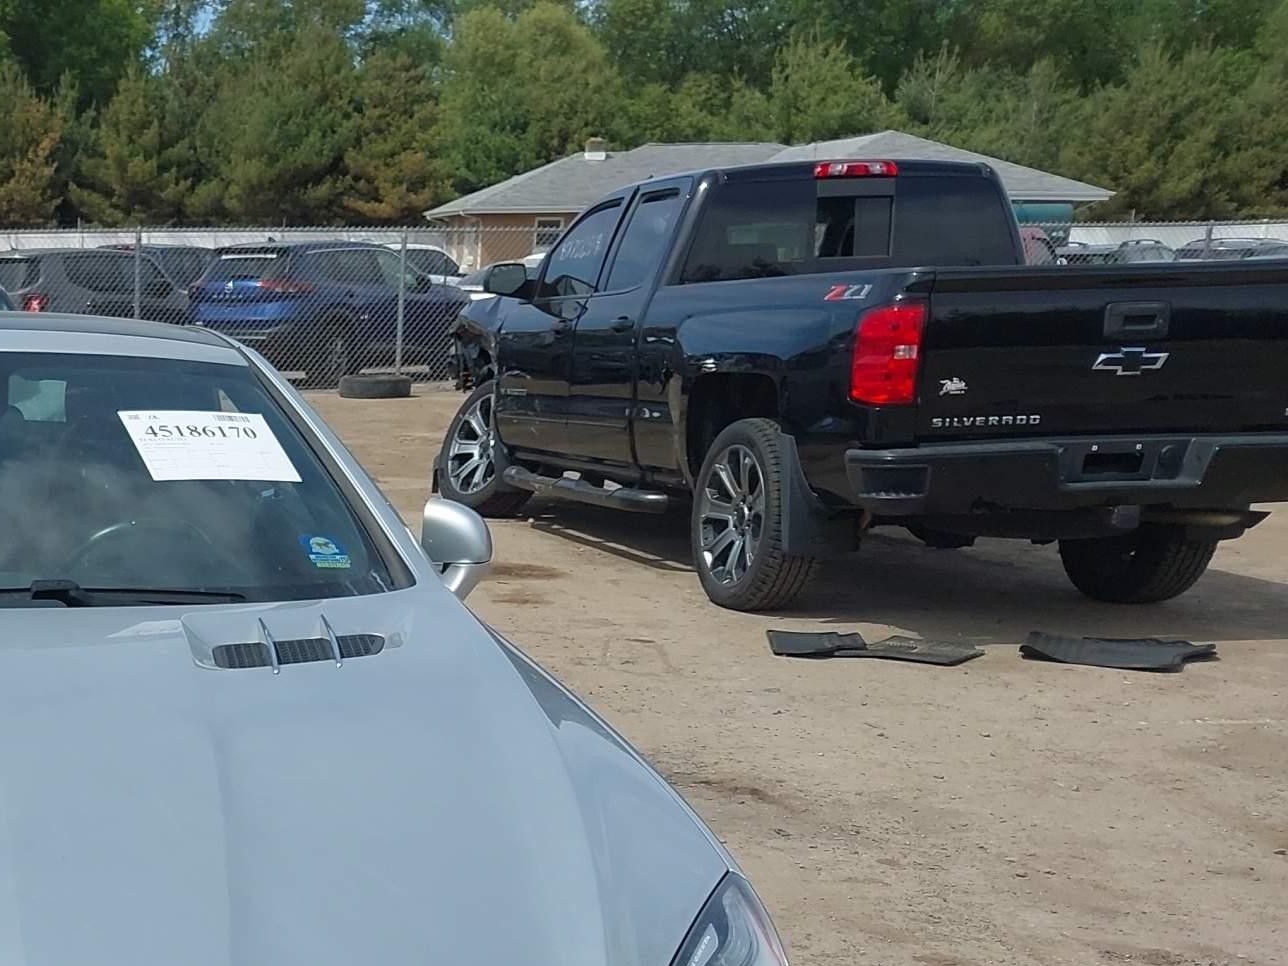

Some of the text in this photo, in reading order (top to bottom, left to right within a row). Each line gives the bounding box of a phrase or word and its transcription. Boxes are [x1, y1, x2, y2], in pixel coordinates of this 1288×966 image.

[824, 283, 873, 301] Z71
[931, 414, 1041, 428] SILVERADO
[144, 424, 258, 440] 45186170
